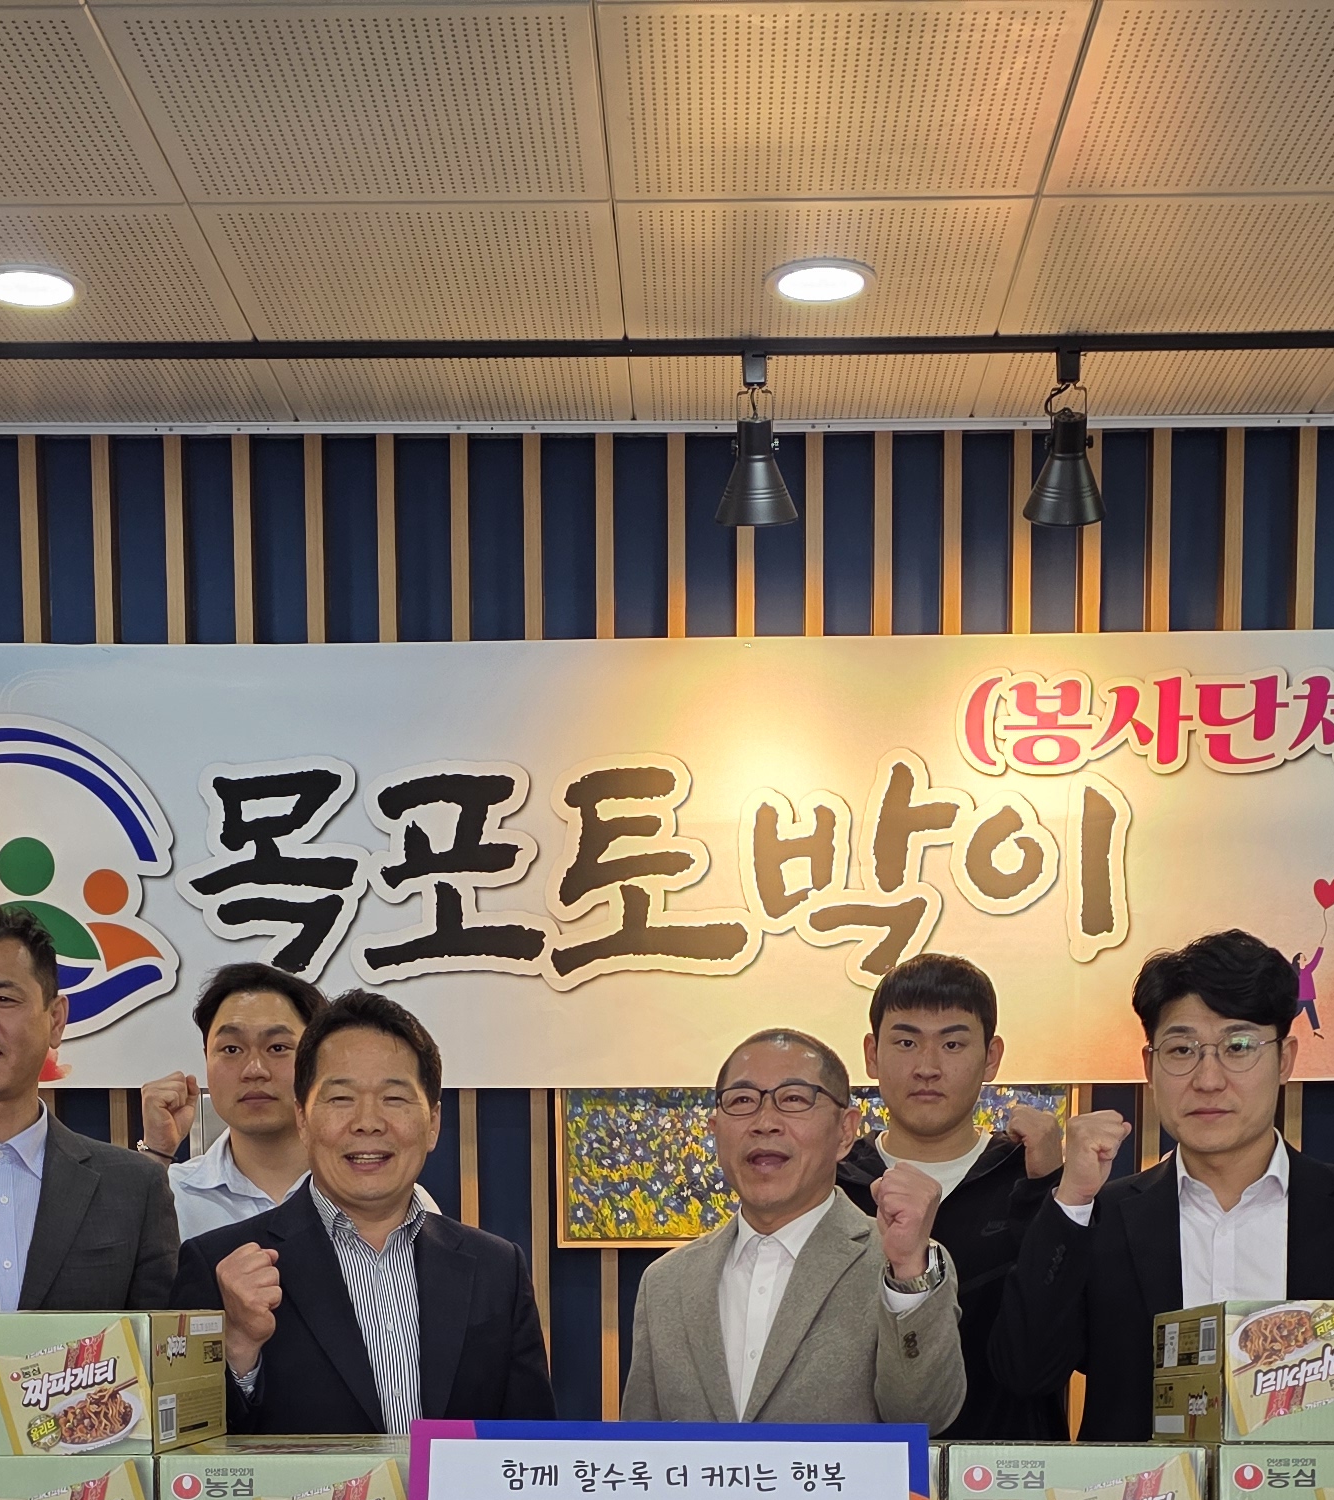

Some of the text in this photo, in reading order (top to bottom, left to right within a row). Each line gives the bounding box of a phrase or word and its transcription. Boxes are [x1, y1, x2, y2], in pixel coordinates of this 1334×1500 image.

[189, 762, 1117, 978] 목포토박이
[21, 1357, 118, 1411] 짜파게티
[501, 1458, 847, 1494] 함께 할수록 더 커지는 행복
